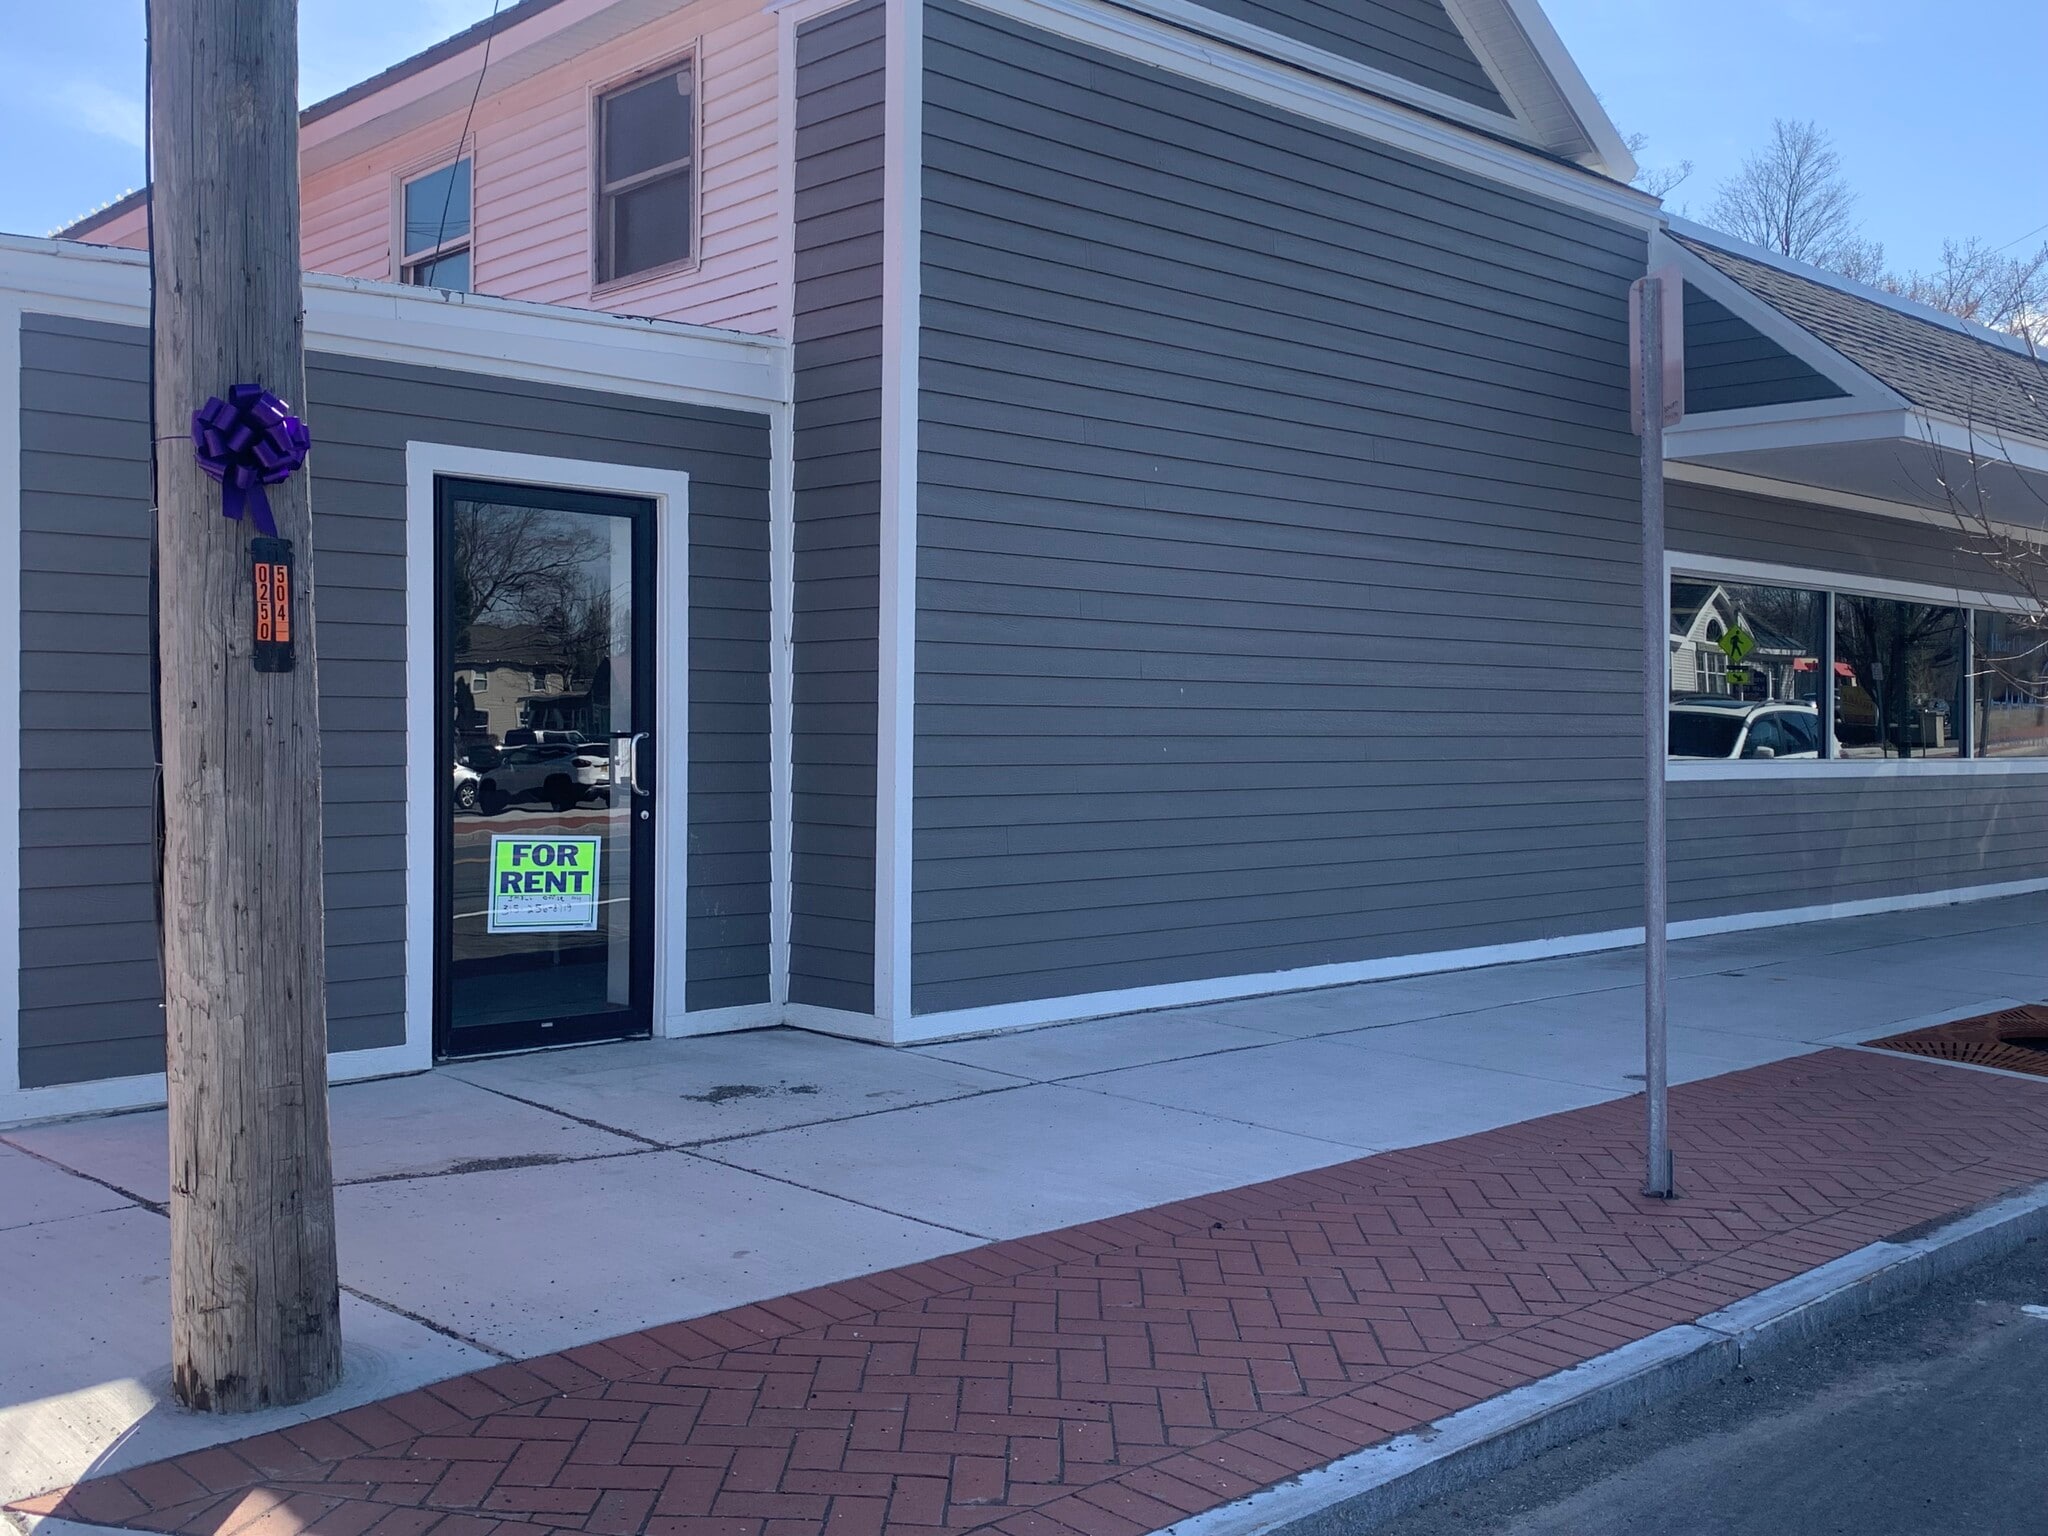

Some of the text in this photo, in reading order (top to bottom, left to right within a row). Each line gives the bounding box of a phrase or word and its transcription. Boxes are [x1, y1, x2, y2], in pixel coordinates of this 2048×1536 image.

[259, 565, 269, 640] 0250
[276, 566, 286, 621] 504
[512, 844, 579, 867] FOR
[500, 871, 590, 893] RENT
